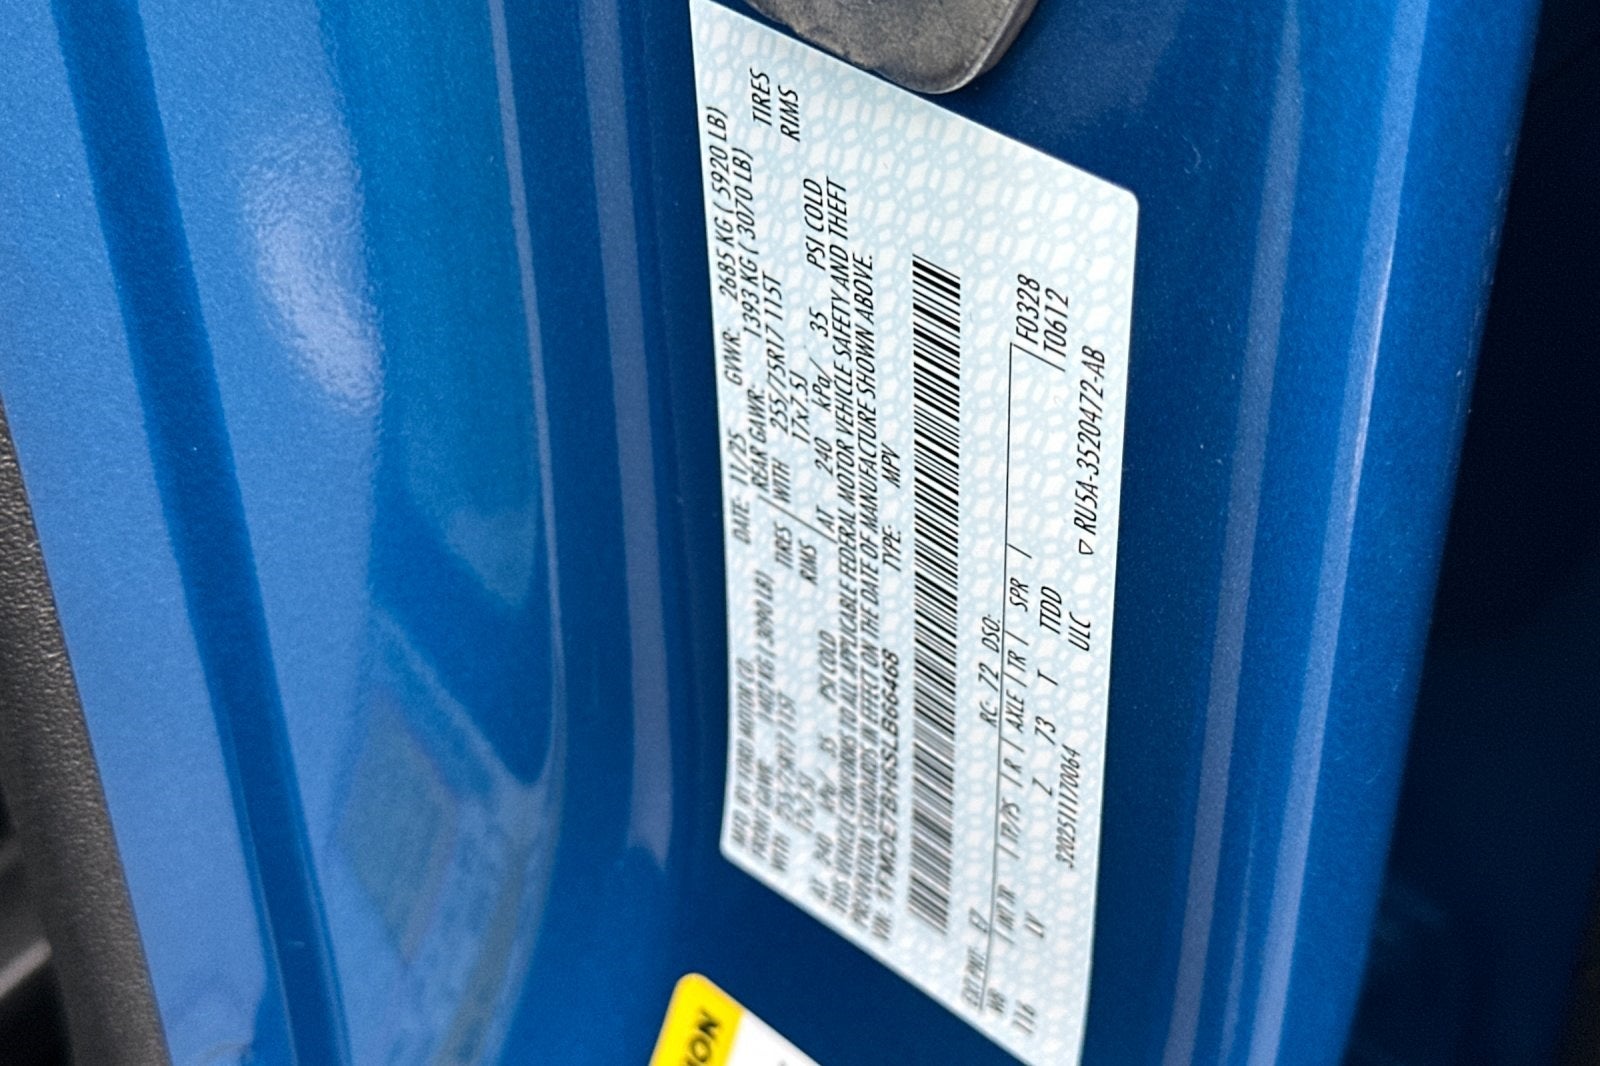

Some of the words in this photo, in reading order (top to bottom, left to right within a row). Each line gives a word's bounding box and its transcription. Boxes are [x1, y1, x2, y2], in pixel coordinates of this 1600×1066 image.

[706, 103, 727, 142] LB)
[750, 66, 771, 129] TIRES
[778, 83, 799, 142] RIMS
[709, 143, 730, 199] 5920
[731, 143, 752, 183] LB)
[734, 183, 755, 240] 3070
[803, 176, 823, 233] COLD
[826, 175, 847, 243] THEFT
[714, 214, 733, 247] KG
[805, 234, 825, 270] PSI
[716, 247, 737, 301] 2685
[739, 254, 758, 287] KG
[829, 241, 849, 291] AND
[853, 247, 874, 324] ABOVE.
[741, 287, 761, 339] 1393
[762, 270, 782, 321] 115T
[1015, 271, 1039, 344] F0328
[809, 306, 828, 338] 35
[831, 288, 851, 361] SAFETY
[1043, 286, 1068, 360] T0612
[722, 323, 742, 387] GVWR:
[765, 323, 788, 434] 255/75R17
[855, 322, 875, 399] SHOWN
[747, 381, 766, 444] GAWR:
[789, 370, 809, 445] 17x7.5J
[833, 360, 853, 438] VEHICLE
[727, 427, 749, 488] 11/25
[813, 434, 832, 475] 240
[1073, 342, 1104, 536] RU5A-3520472-AB
[750, 444, 768, 492] REAR
[771, 456, 790, 506] WITH
[836, 437, 855, 507] MOTOR
[857, 397, 877, 534] MANUFACTURE
[881, 441, 900, 488] MPV
[730, 493, 750, 546] DATE:
[816, 505, 834, 533] AT
[838, 504, 856, 581] FEDERAL
[774, 520, 792, 570] TIRES
[798, 538, 816, 585] RIMS
[860, 530, 878, 560] OF
[883, 522, 900, 572] TYPE:
[754, 567, 773, 602] LB)
[860, 556, 878, 606] DATE
[1009, 575, 1028, 612] SPR
[755, 597, 773, 647] 3090
[839, 578, 856, 679] APPLICABLE
[860, 601, 878, 640] THE
[981, 610, 1000, 653] DSO:
[1039, 583, 1062, 635] TTDD
[1068, 610, 1090, 652] ULC
[757, 654, 774, 683] KG
[818, 627, 835, 674] COLD
[860, 637, 878, 669] ON
[1007, 648, 1025, 673] TR
[839, 675, 856, 710] ALL
[860, 666, 878, 724] EFFECT
[978, 660, 998, 692] 72
[839, 704, 856, 733] TO
[860, 721, 877, 747] IN
[980, 698, 997, 727] RC:
[1004, 688, 1024, 734] AXLE
[1034, 714, 1055, 746] 73
[838, 728, 856, 818] CONFORMS
[858, 742, 877, 834] STANDARDS
[1055, 743, 1079, 869] 3202511170064
